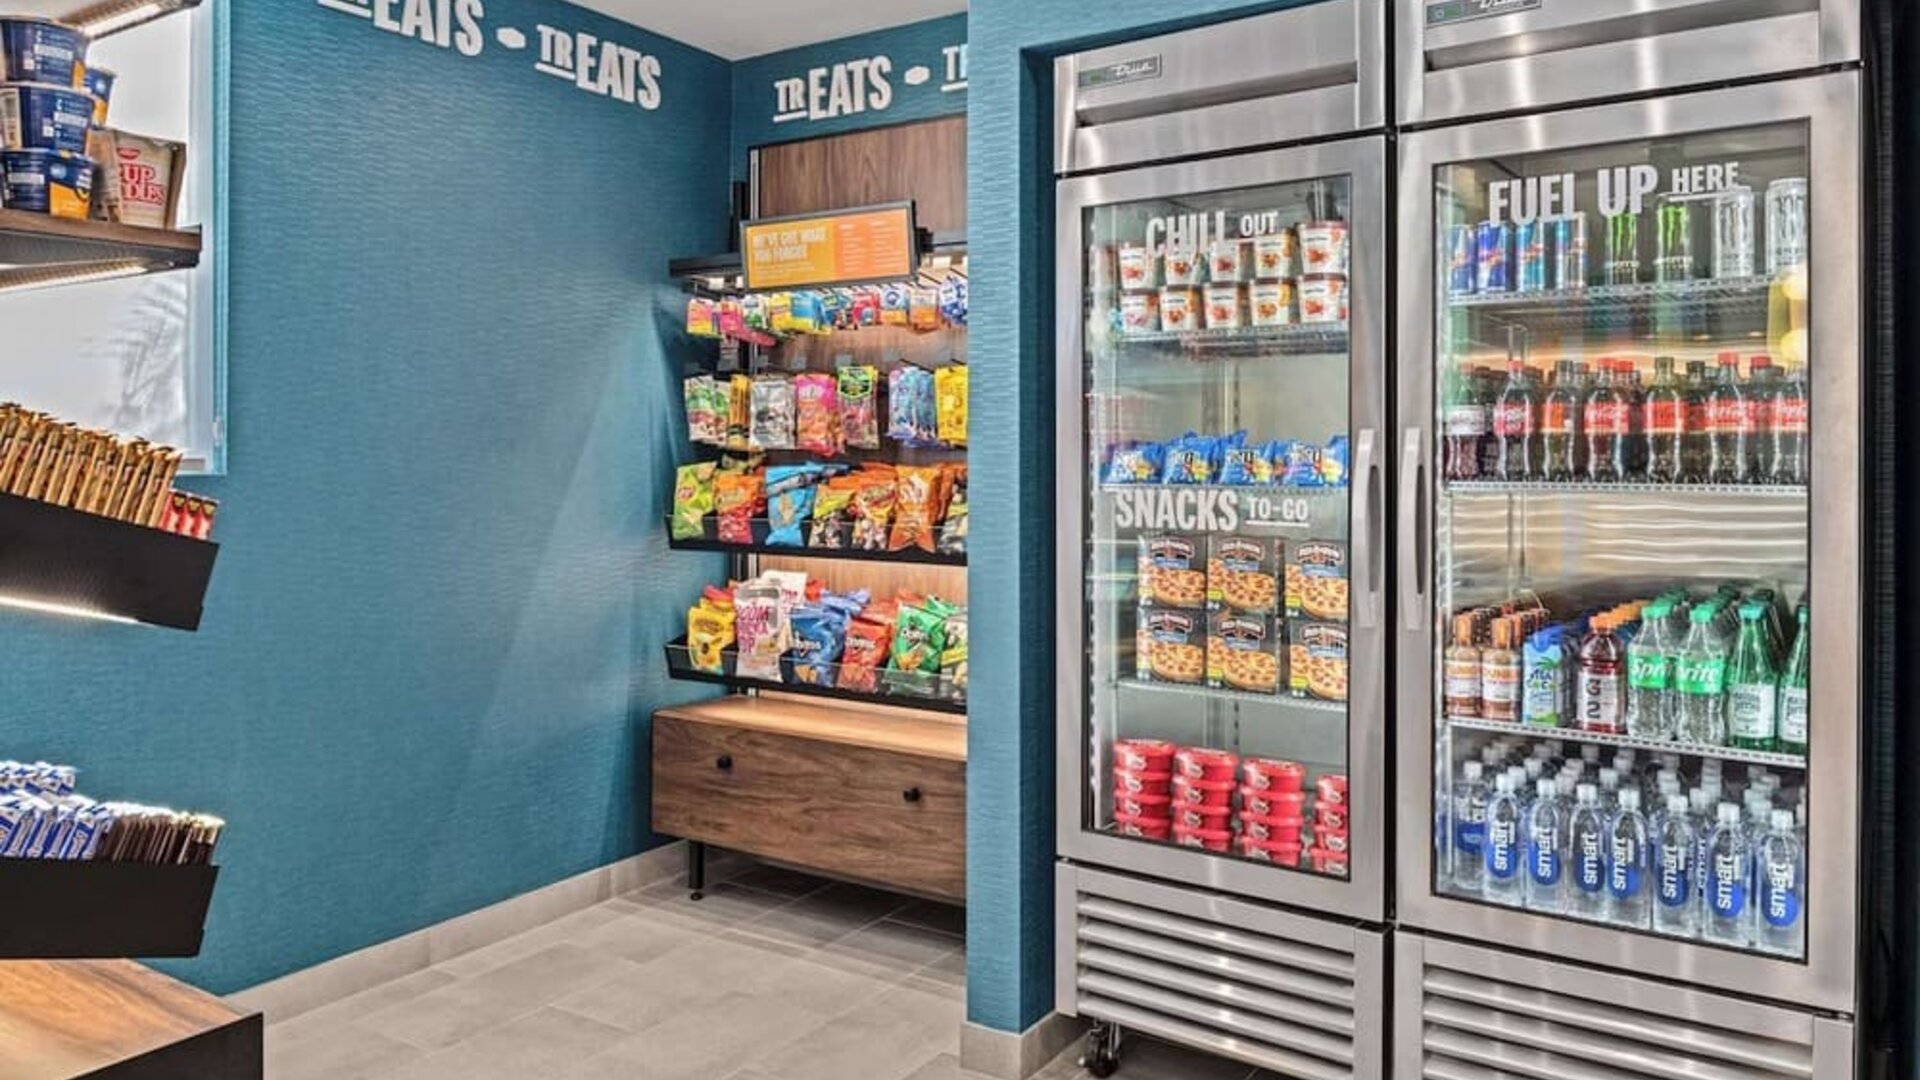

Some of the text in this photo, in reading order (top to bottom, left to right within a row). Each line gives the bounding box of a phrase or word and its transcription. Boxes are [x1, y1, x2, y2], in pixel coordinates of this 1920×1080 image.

[320, 0, 484, 56] EATS
[535, 24, 661, 110] TREATS
[773, 56, 892, 122] TREATS
[119, 163, 156, 183] UP
[1489, 161, 1740, 228] FUEL UP HERE
[1146, 210, 1279, 258] CHILL OUT
[1115, 488, 1309, 531] SNACKS TO-GO
[1681, 663, 1719, 685] rite
[1494, 821, 1508, 871] smart
[1538, 826, 1552, 878] smart
[1581, 832, 1598, 885] smart
[1613, 837, 1627, 890] smart
[1662, 845, 1677, 898] smart
[1716, 854, 1733, 909] smart
[1769, 863, 1786, 917] smart
